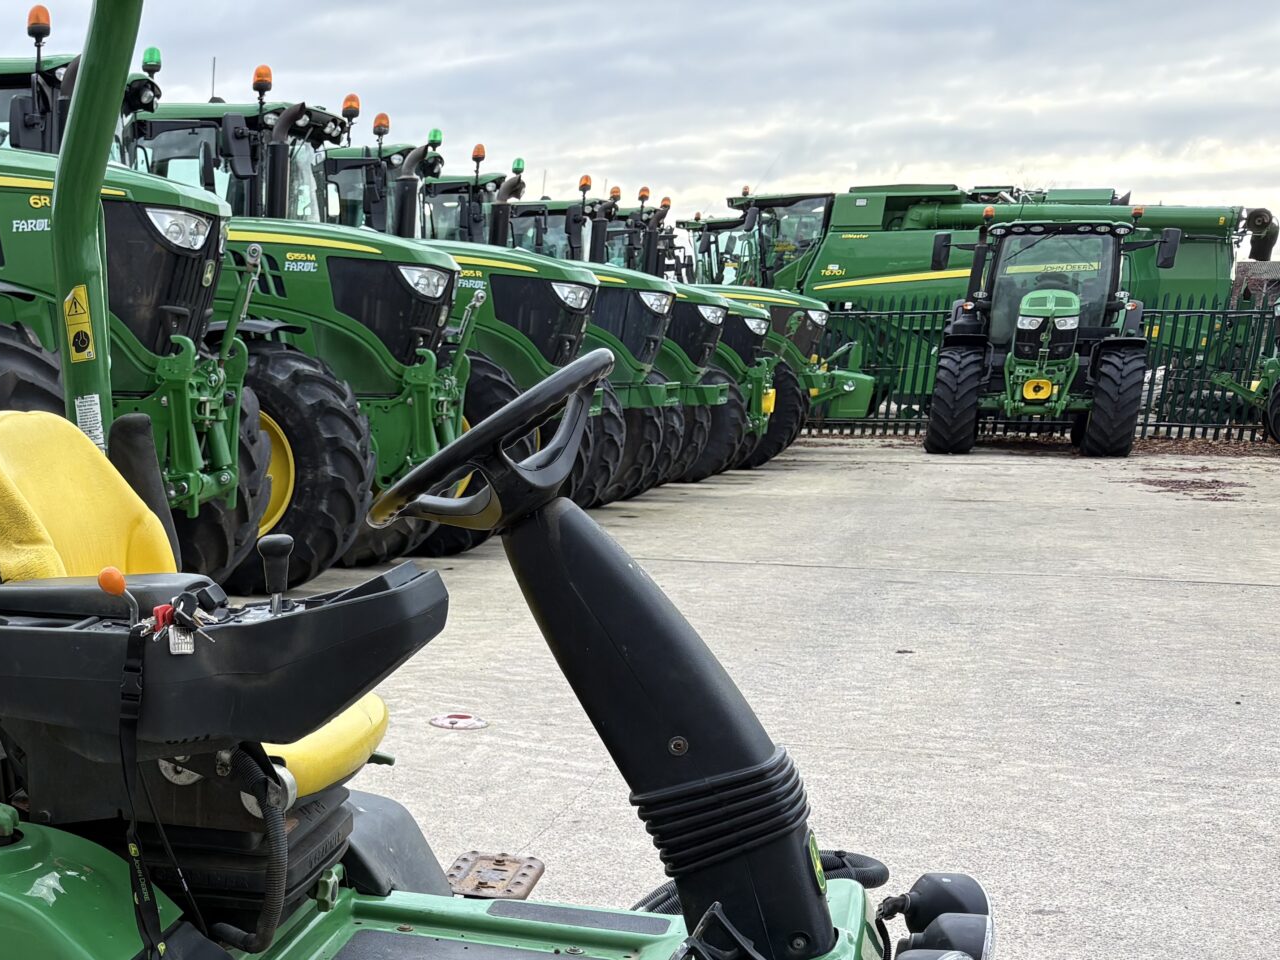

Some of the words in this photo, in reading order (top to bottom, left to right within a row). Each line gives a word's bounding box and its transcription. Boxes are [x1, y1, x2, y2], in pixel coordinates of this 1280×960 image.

[29, 195, 51, 208] 6R
[12, 219, 51, 232] FAROL
[284, 261, 318, 272] FAROL
[1042, 264, 1065, 273] JOHN
